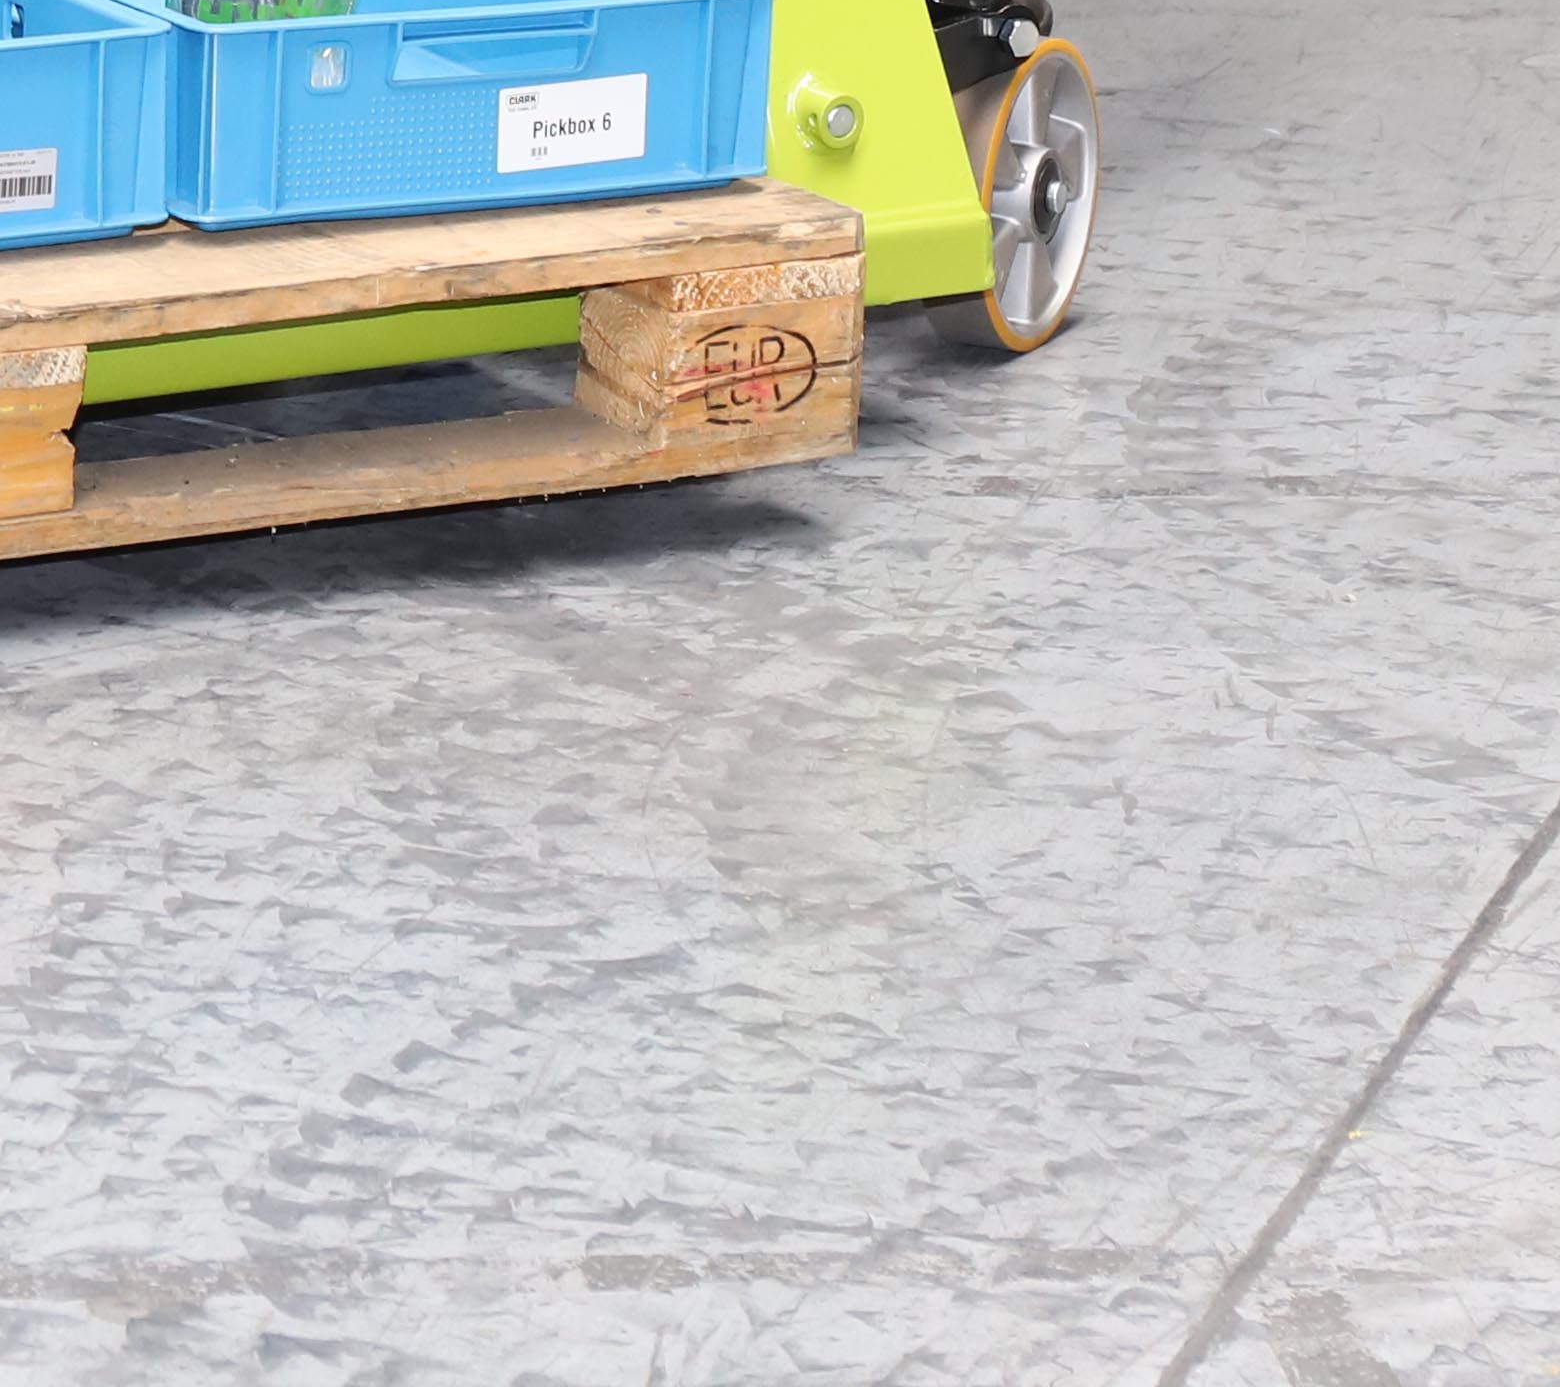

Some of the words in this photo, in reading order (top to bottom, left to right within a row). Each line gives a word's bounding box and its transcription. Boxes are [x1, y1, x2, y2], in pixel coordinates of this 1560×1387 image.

[509, 95, 536, 105] CLARK
[533, 117, 596, 139] Pickbox
[602, 112, 612, 131] 6
